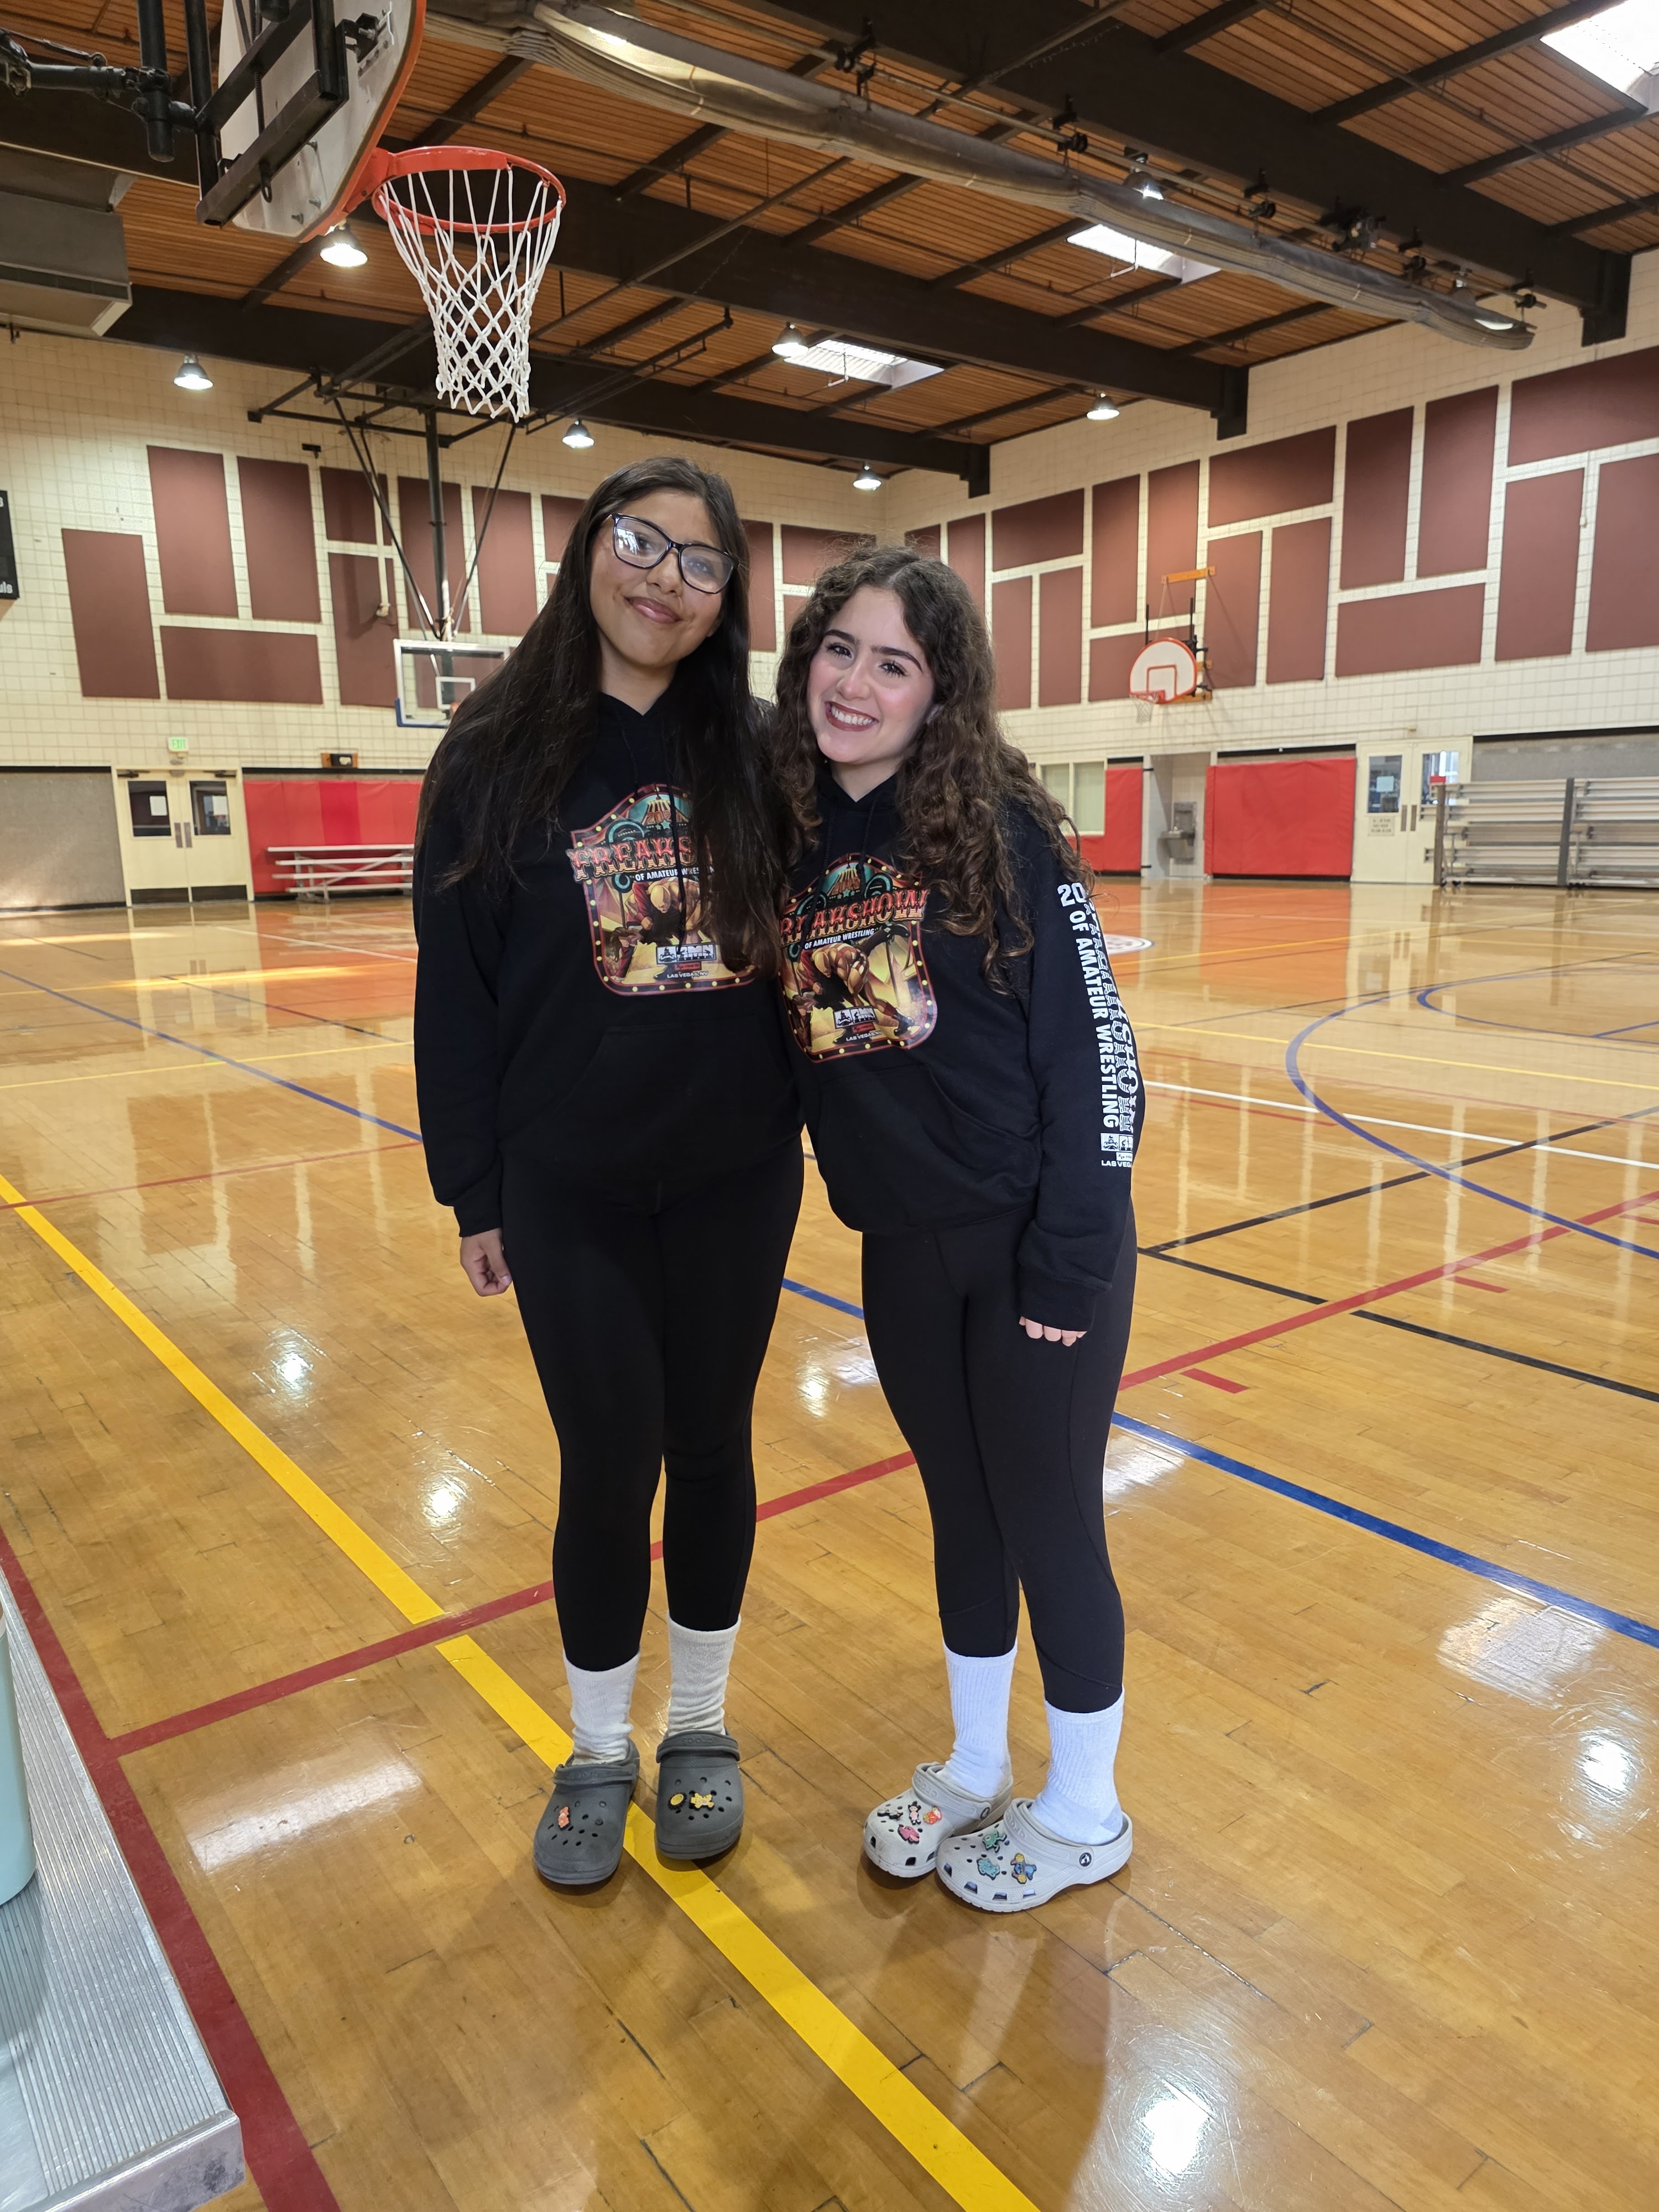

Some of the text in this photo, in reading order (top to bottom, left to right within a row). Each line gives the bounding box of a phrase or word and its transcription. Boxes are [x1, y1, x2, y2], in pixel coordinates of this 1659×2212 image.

[171, 739, 186, 749] EXIT
[635, 873, 645, 881] OF
[780, 888, 930, 946] REAKSHOW
[813, 935, 841, 947] AMATEUR
[843, 928, 874, 941] WRESTLING
[1069, 910, 1119, 1128] OF AMATEUR WRESTLING
